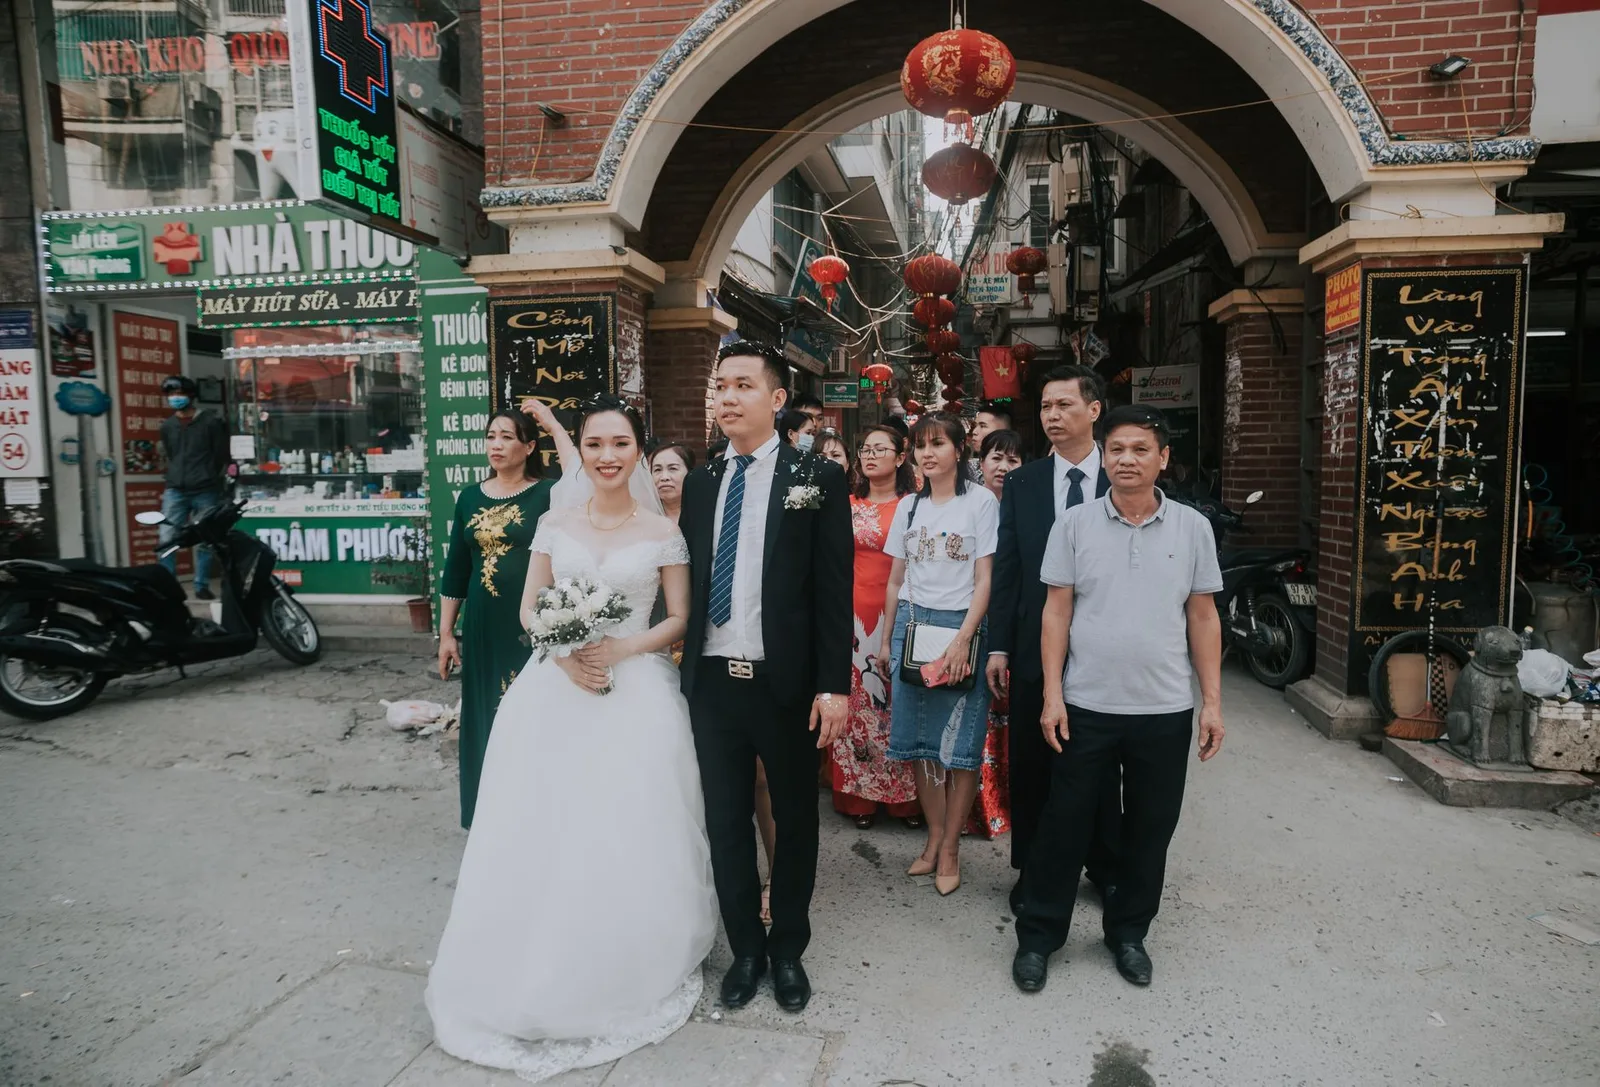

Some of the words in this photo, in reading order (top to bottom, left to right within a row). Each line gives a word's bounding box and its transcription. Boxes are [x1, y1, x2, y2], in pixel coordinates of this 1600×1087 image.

[146, 36, 228, 74] KHO
[319, 108, 370, 150] THUỐC
[370, 135, 395, 163] TỐT
[334, 146, 362, 175] GIÁ
[362, 157, 388, 186] TỐT
[378, 192, 400, 219] TỐT
[212, 212, 300, 276] NHÀ
[1327, 264, 1360, 297] PHOTO
[203, 293, 251, 315] MÁY
[251, 291, 296, 313] HÚT
[298, 289, 341, 311] SỮA
[354, 287, 403, 309] MÁY
[1399, 284, 1483, 318] Làng
[507, 309, 594, 338] Cổng
[1404, 315, 1475, 335] Vào
[441, 353, 457, 373] KÊ
[460, 354, 487, 373] ĐƠN
[1388, 347, 1487, 381] Trong
[440, 378, 466, 401] BỆNH
[467, 377, 490, 400] VIỆN
[1149, 375, 1182, 387] Castrol
[1154, 389, 1174, 398] Point
[442, 412, 459, 432] KÊ
[462, 413, 489, 432] ĐƠN
[3, 443, 25, 460] 54
[436, 435, 469, 456] PHÒNG
[445, 464, 470, 487] VẬT
[255, 521, 330, 561] TRÂM
